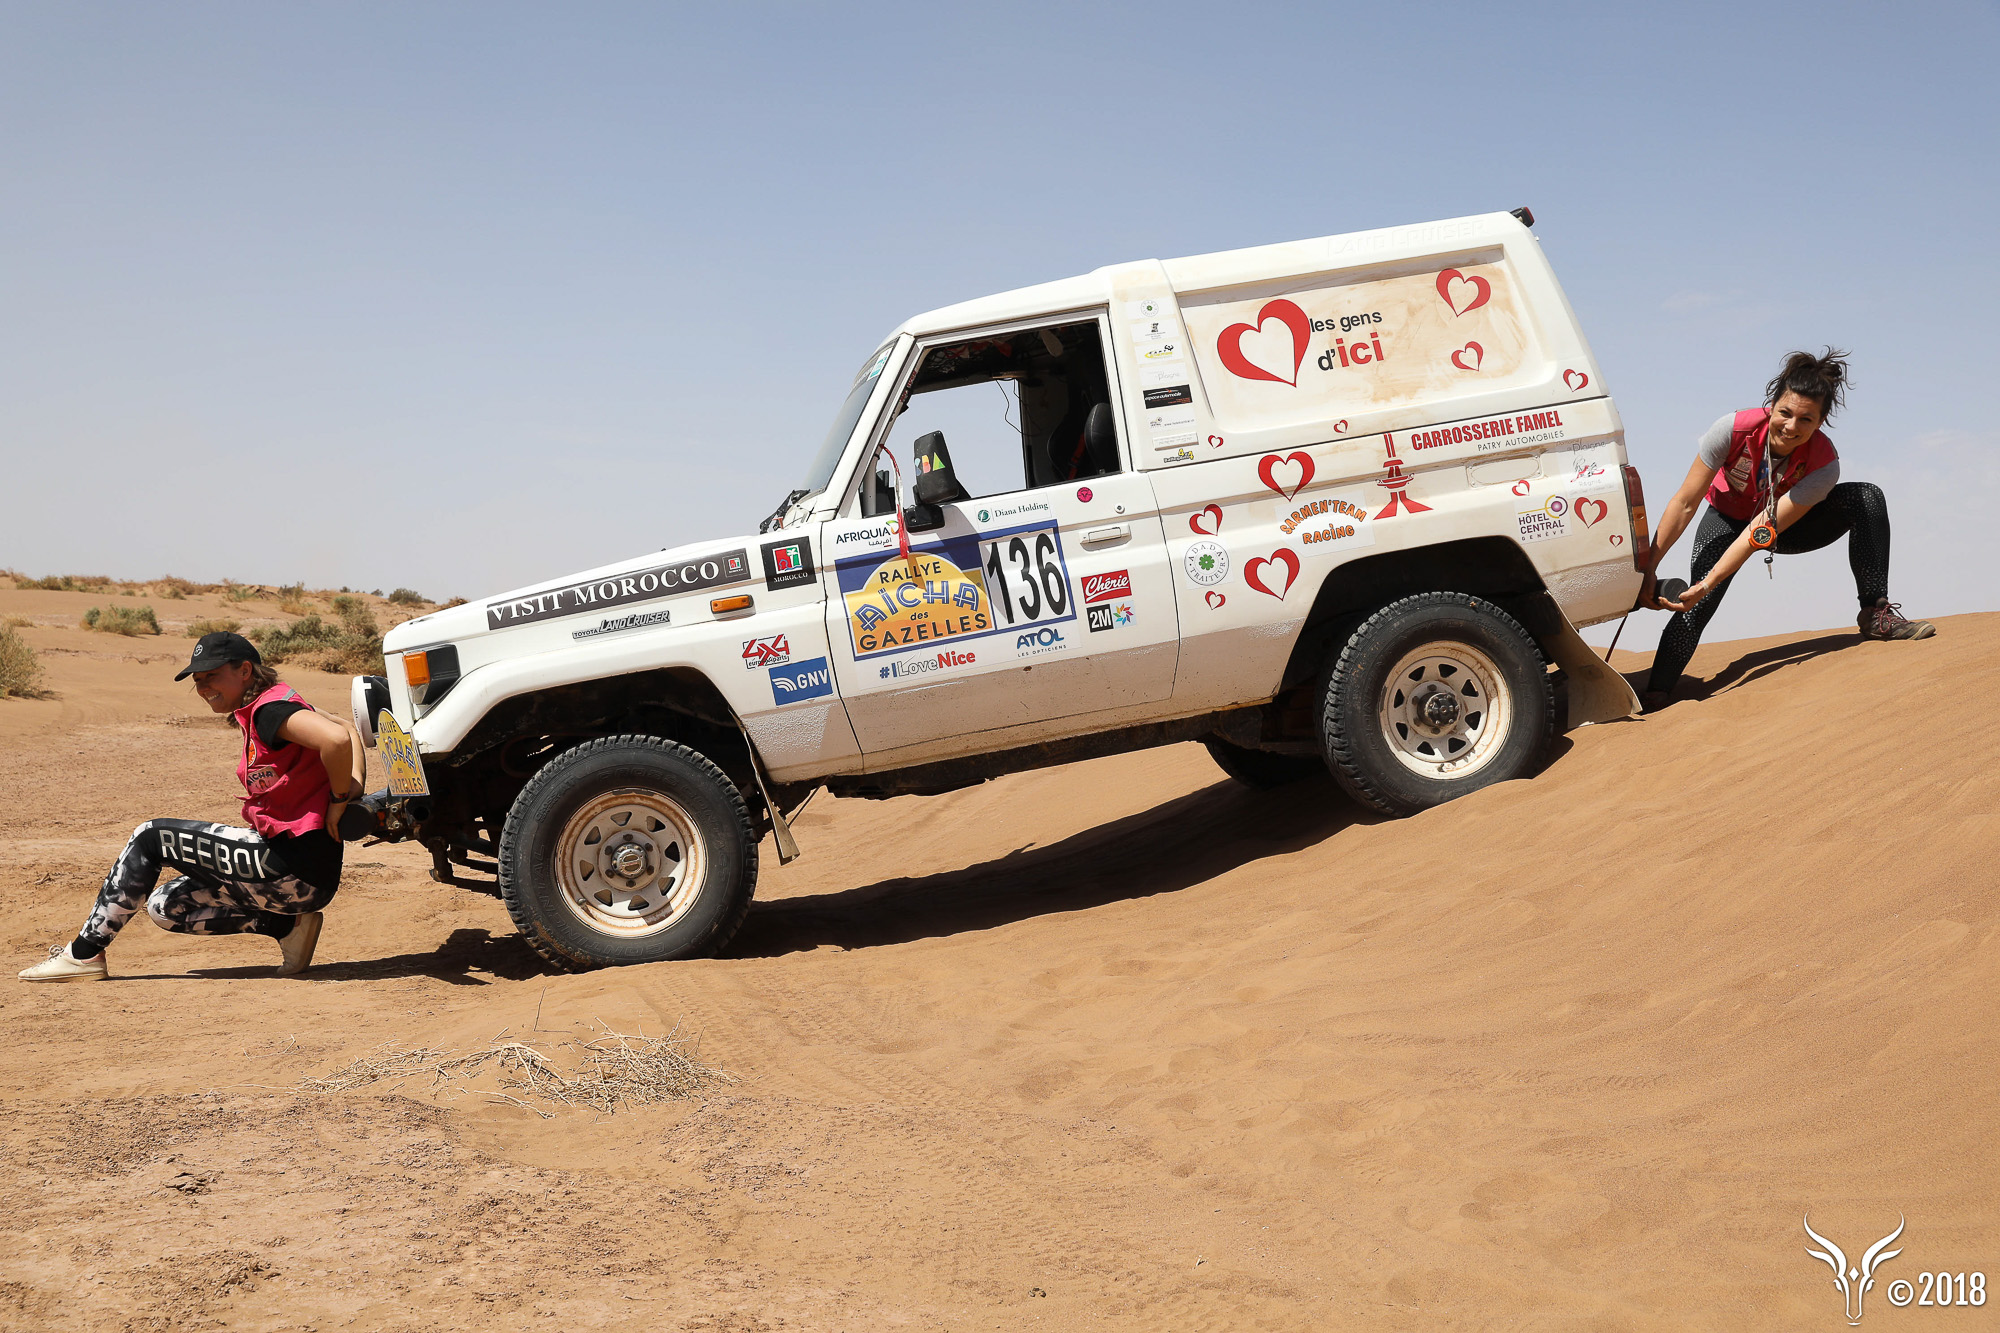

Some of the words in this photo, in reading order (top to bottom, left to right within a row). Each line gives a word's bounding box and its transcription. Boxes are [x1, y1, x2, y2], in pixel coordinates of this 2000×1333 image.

[1309, 318, 1336, 333] les
[1340, 312, 1383, 332] gens
[1411, 417, 1514, 451] CARROSSERIE
[1516, 410, 1563, 433] FAMEL
[1477, 441, 1502, 452] PATRY
[1505, 430, 1565, 447] AUTOMOBILES
[994, 508, 1017, 517] Diana
[1018, 502, 1049, 513] Holding
[1518, 513, 1549, 525] HÔTEL
[836, 526, 891, 544] AFRIQUIA
[1520, 520, 1565, 535] CENTRAL
[879, 561, 942, 584] RALLYE
[987, 532, 1066, 624] 136
[487, 591, 565, 622] VISIT
[574, 561, 719, 606] MOROCCO
[1085, 575, 1129, 597] Chérie
[910, 611, 929, 621] des
[1090, 609, 1112, 628] 2M
[574, 628, 598, 638] TOYOTA
[859, 613, 987, 651] GAZELLES
[1017, 628, 1064, 649] ATOL
[1032, 644, 1067, 655] OPTICIENS
[796, 668, 828, 689] GNV
[159, 829, 280, 879] REEBOK
